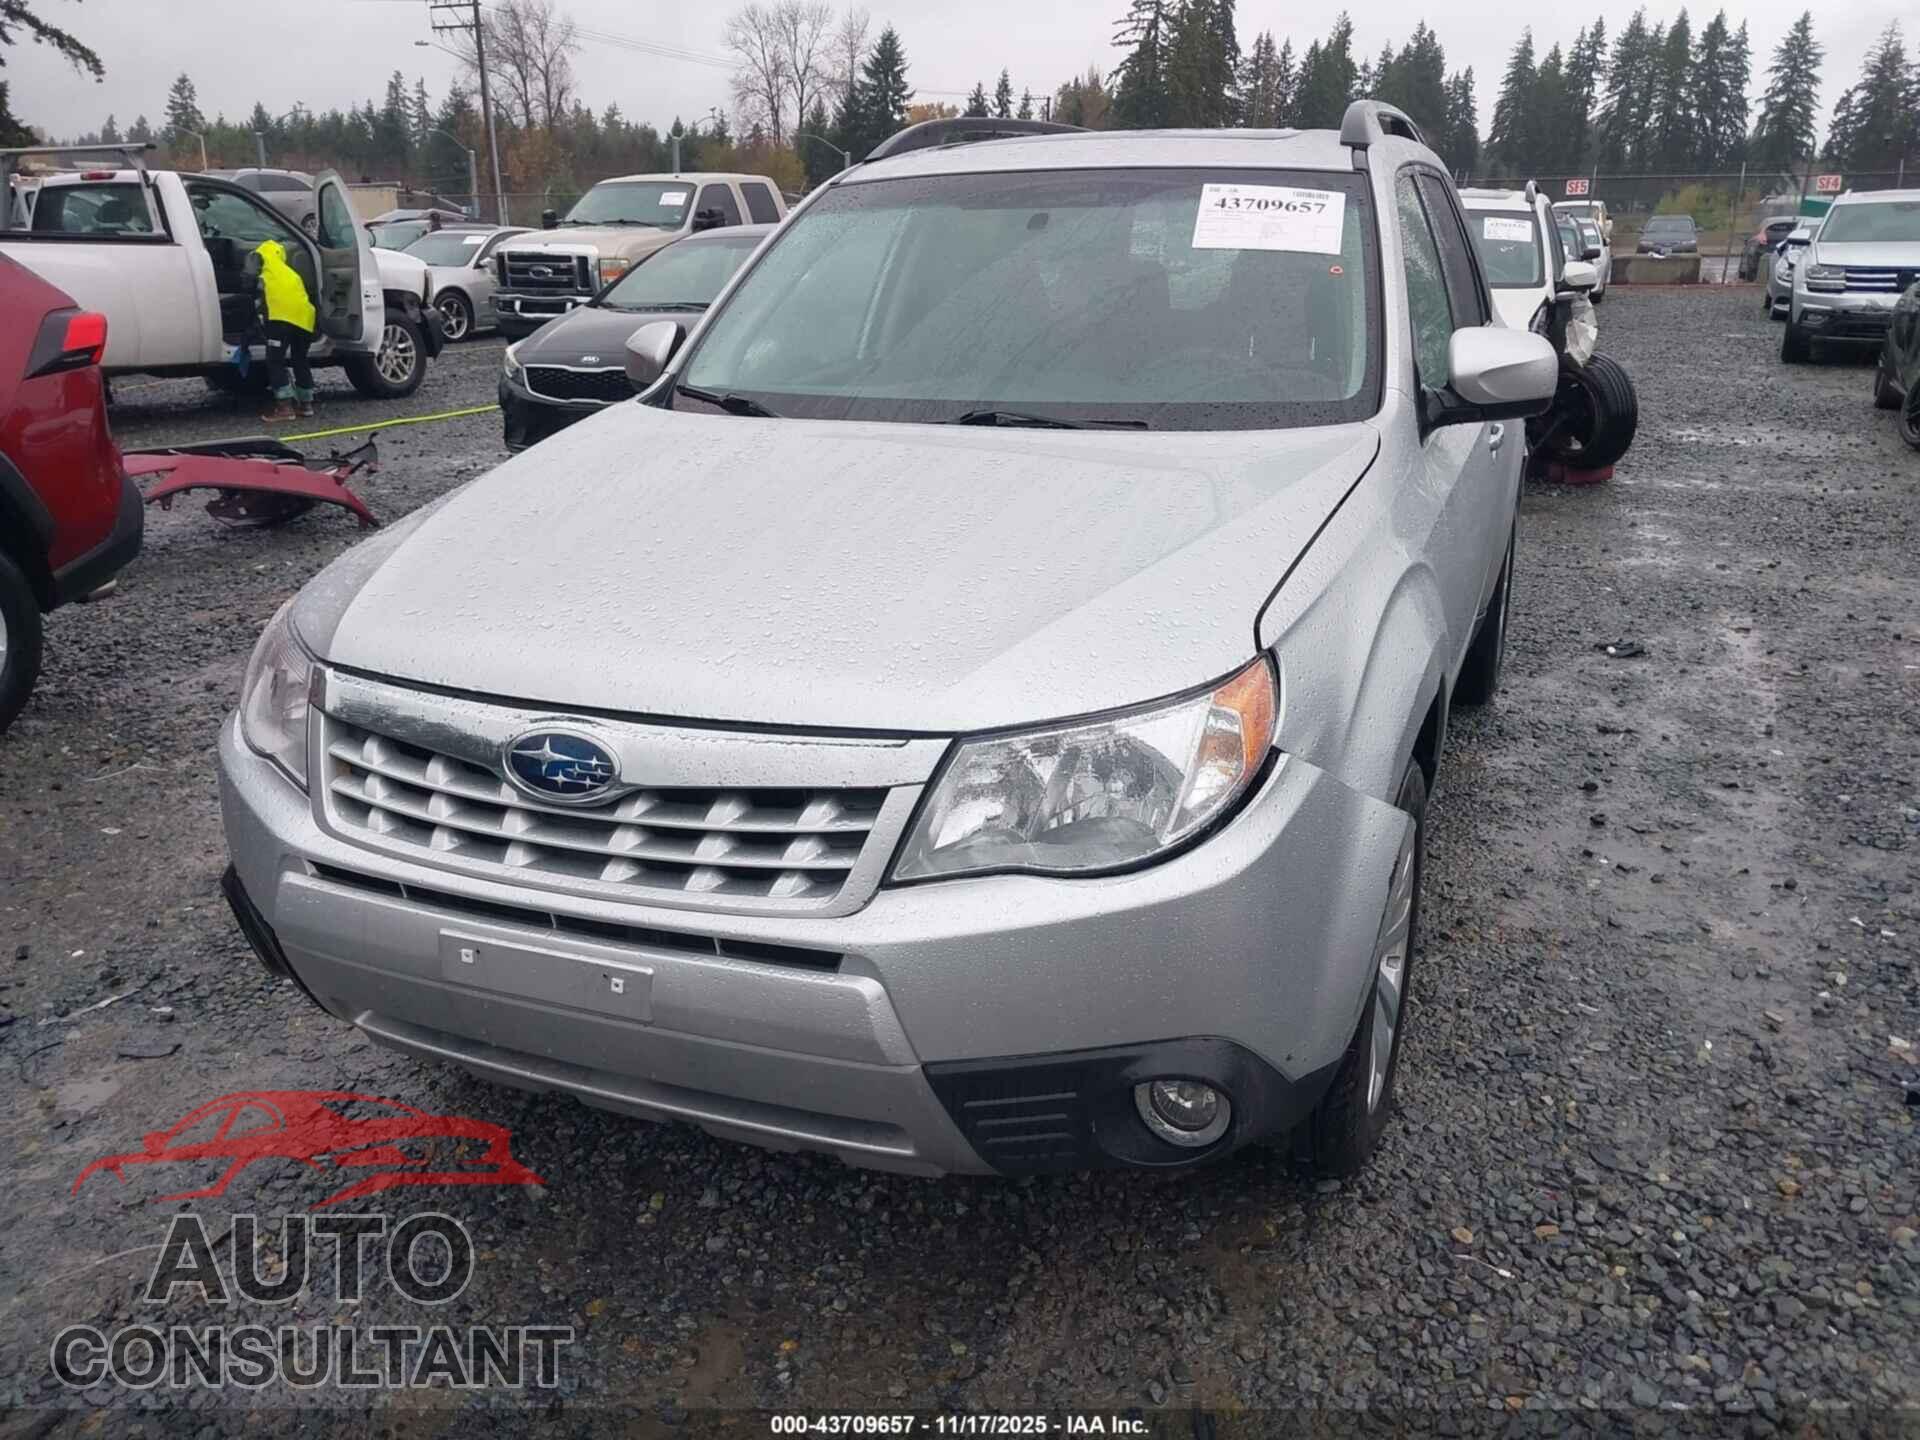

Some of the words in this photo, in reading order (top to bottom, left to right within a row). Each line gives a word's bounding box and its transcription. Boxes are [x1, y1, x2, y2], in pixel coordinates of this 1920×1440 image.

[1567, 181, 1588, 193] SF5
[1818, 176, 1839, 189] SF4
[1214, 197, 1327, 214] 43709657
